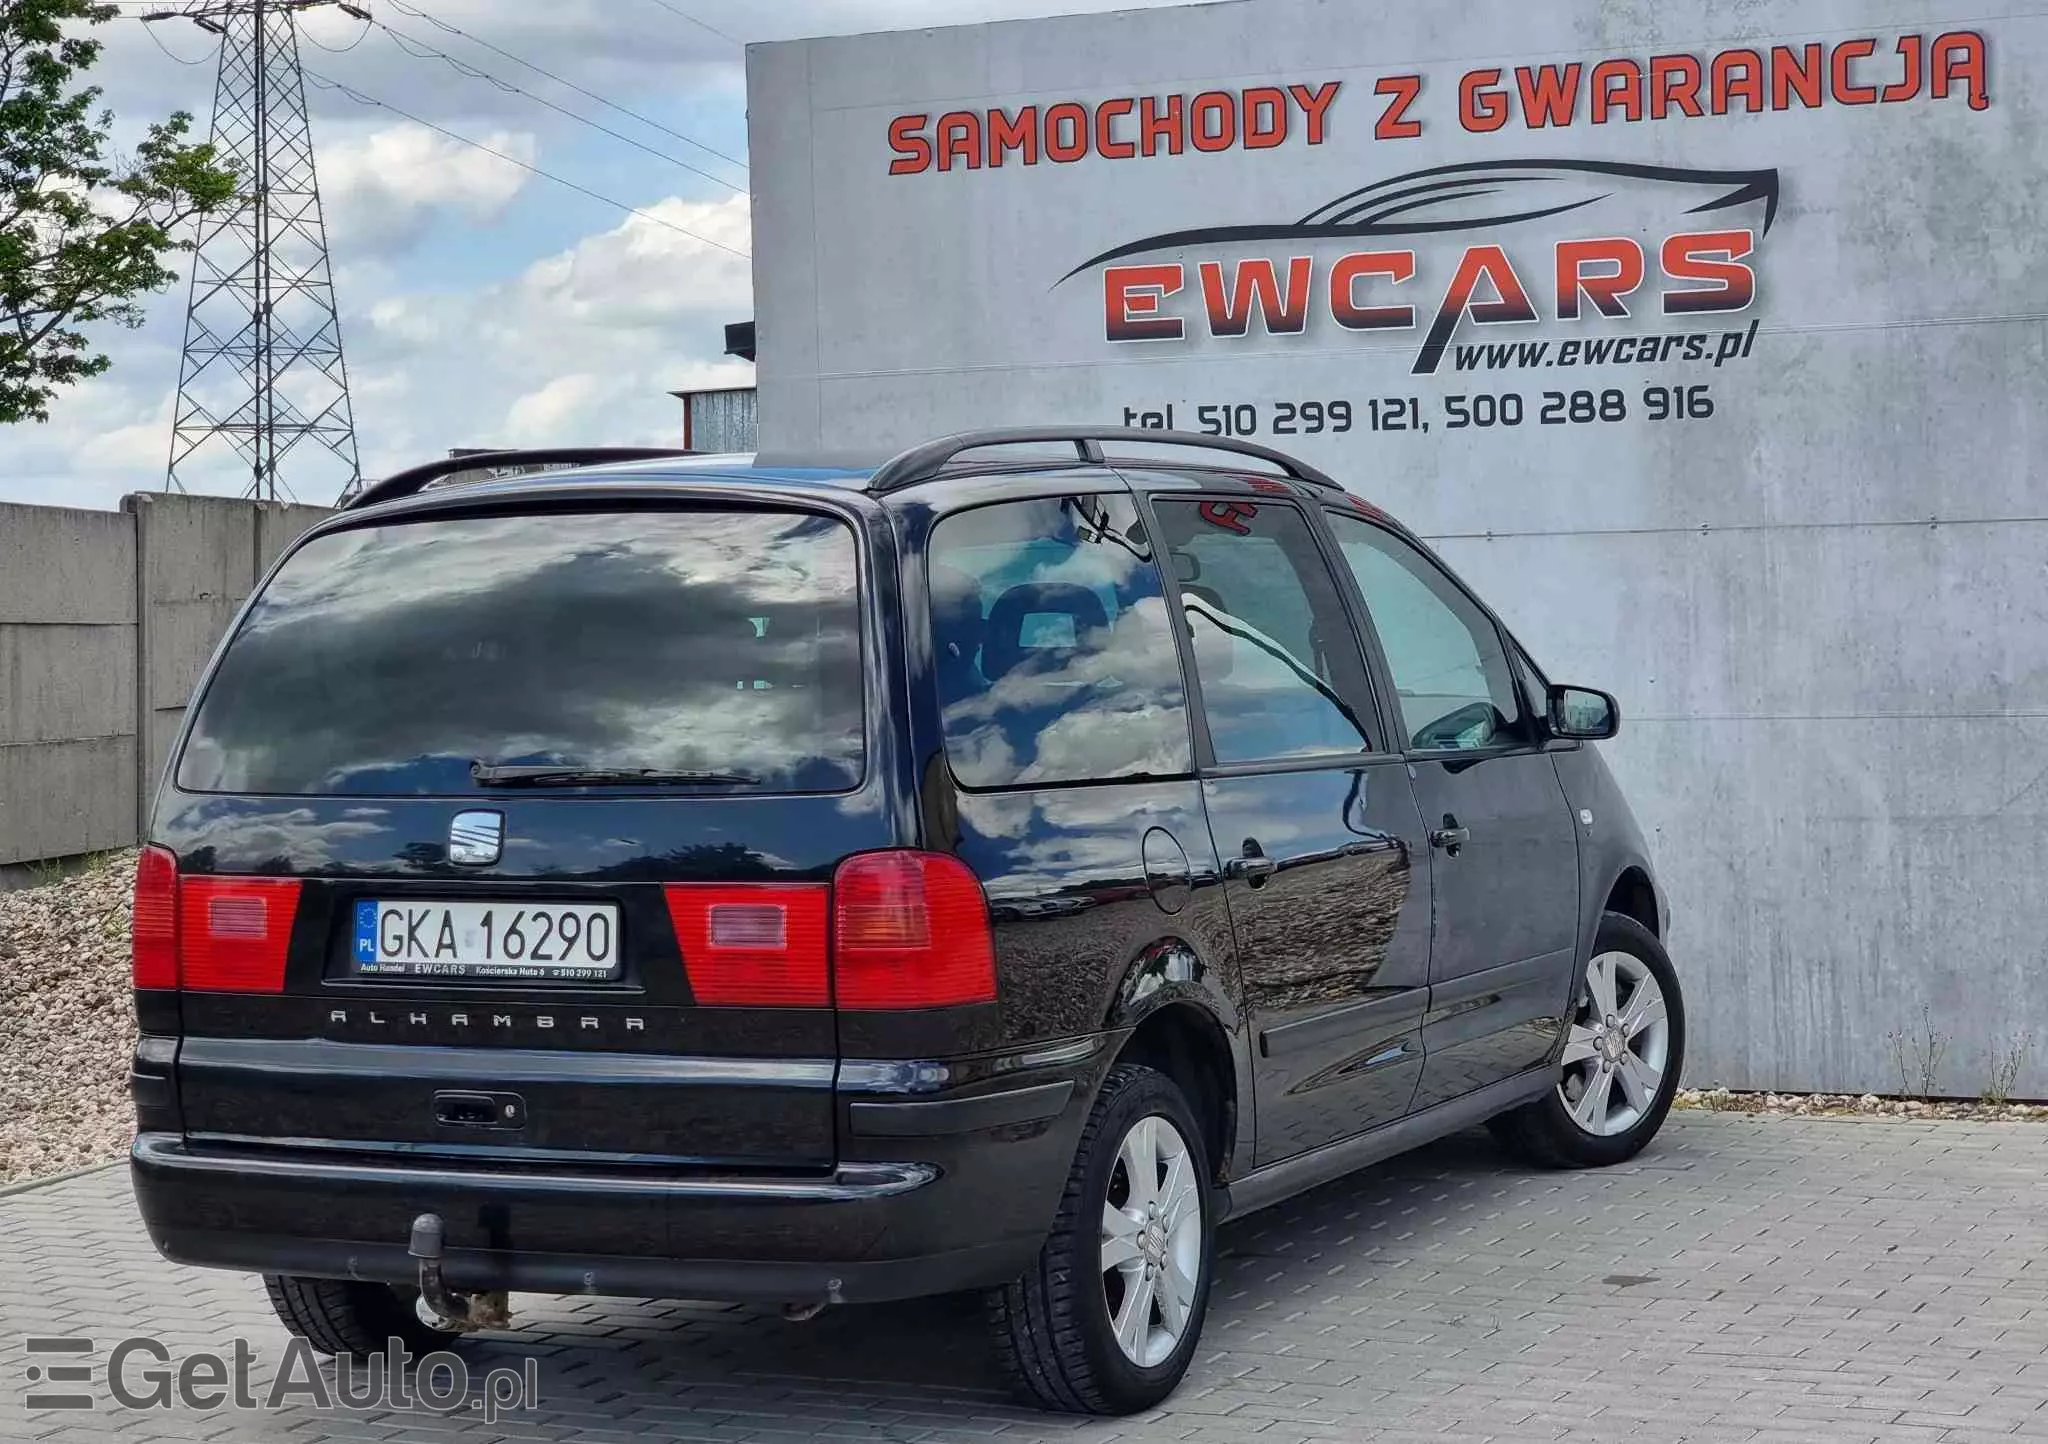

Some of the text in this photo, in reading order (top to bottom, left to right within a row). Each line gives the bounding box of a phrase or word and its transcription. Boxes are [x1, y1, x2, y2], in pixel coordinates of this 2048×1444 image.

[887, 30, 1991, 176] SAMOCHODY Z GWARANCJĄ
[1104, 228, 1758, 375] EWCARS
[1454, 319, 1760, 370] www.ewcars.pl
[1198, 404, 1257, 437] 510
[1272, 400, 1352, 434] 299
[1368, 397, 1429, 434] 121,
[1445, 393, 1524, 428] 500
[1540, 389, 1627, 424] 288
[1643, 385, 1715, 420] 916
[359, 908, 610, 962] PL GKA 16290
[360, 963, 378, 972] Auto
[415, 963, 466, 975] EWCARS
[331, 1010, 644, 1031] ALHAMBRA
